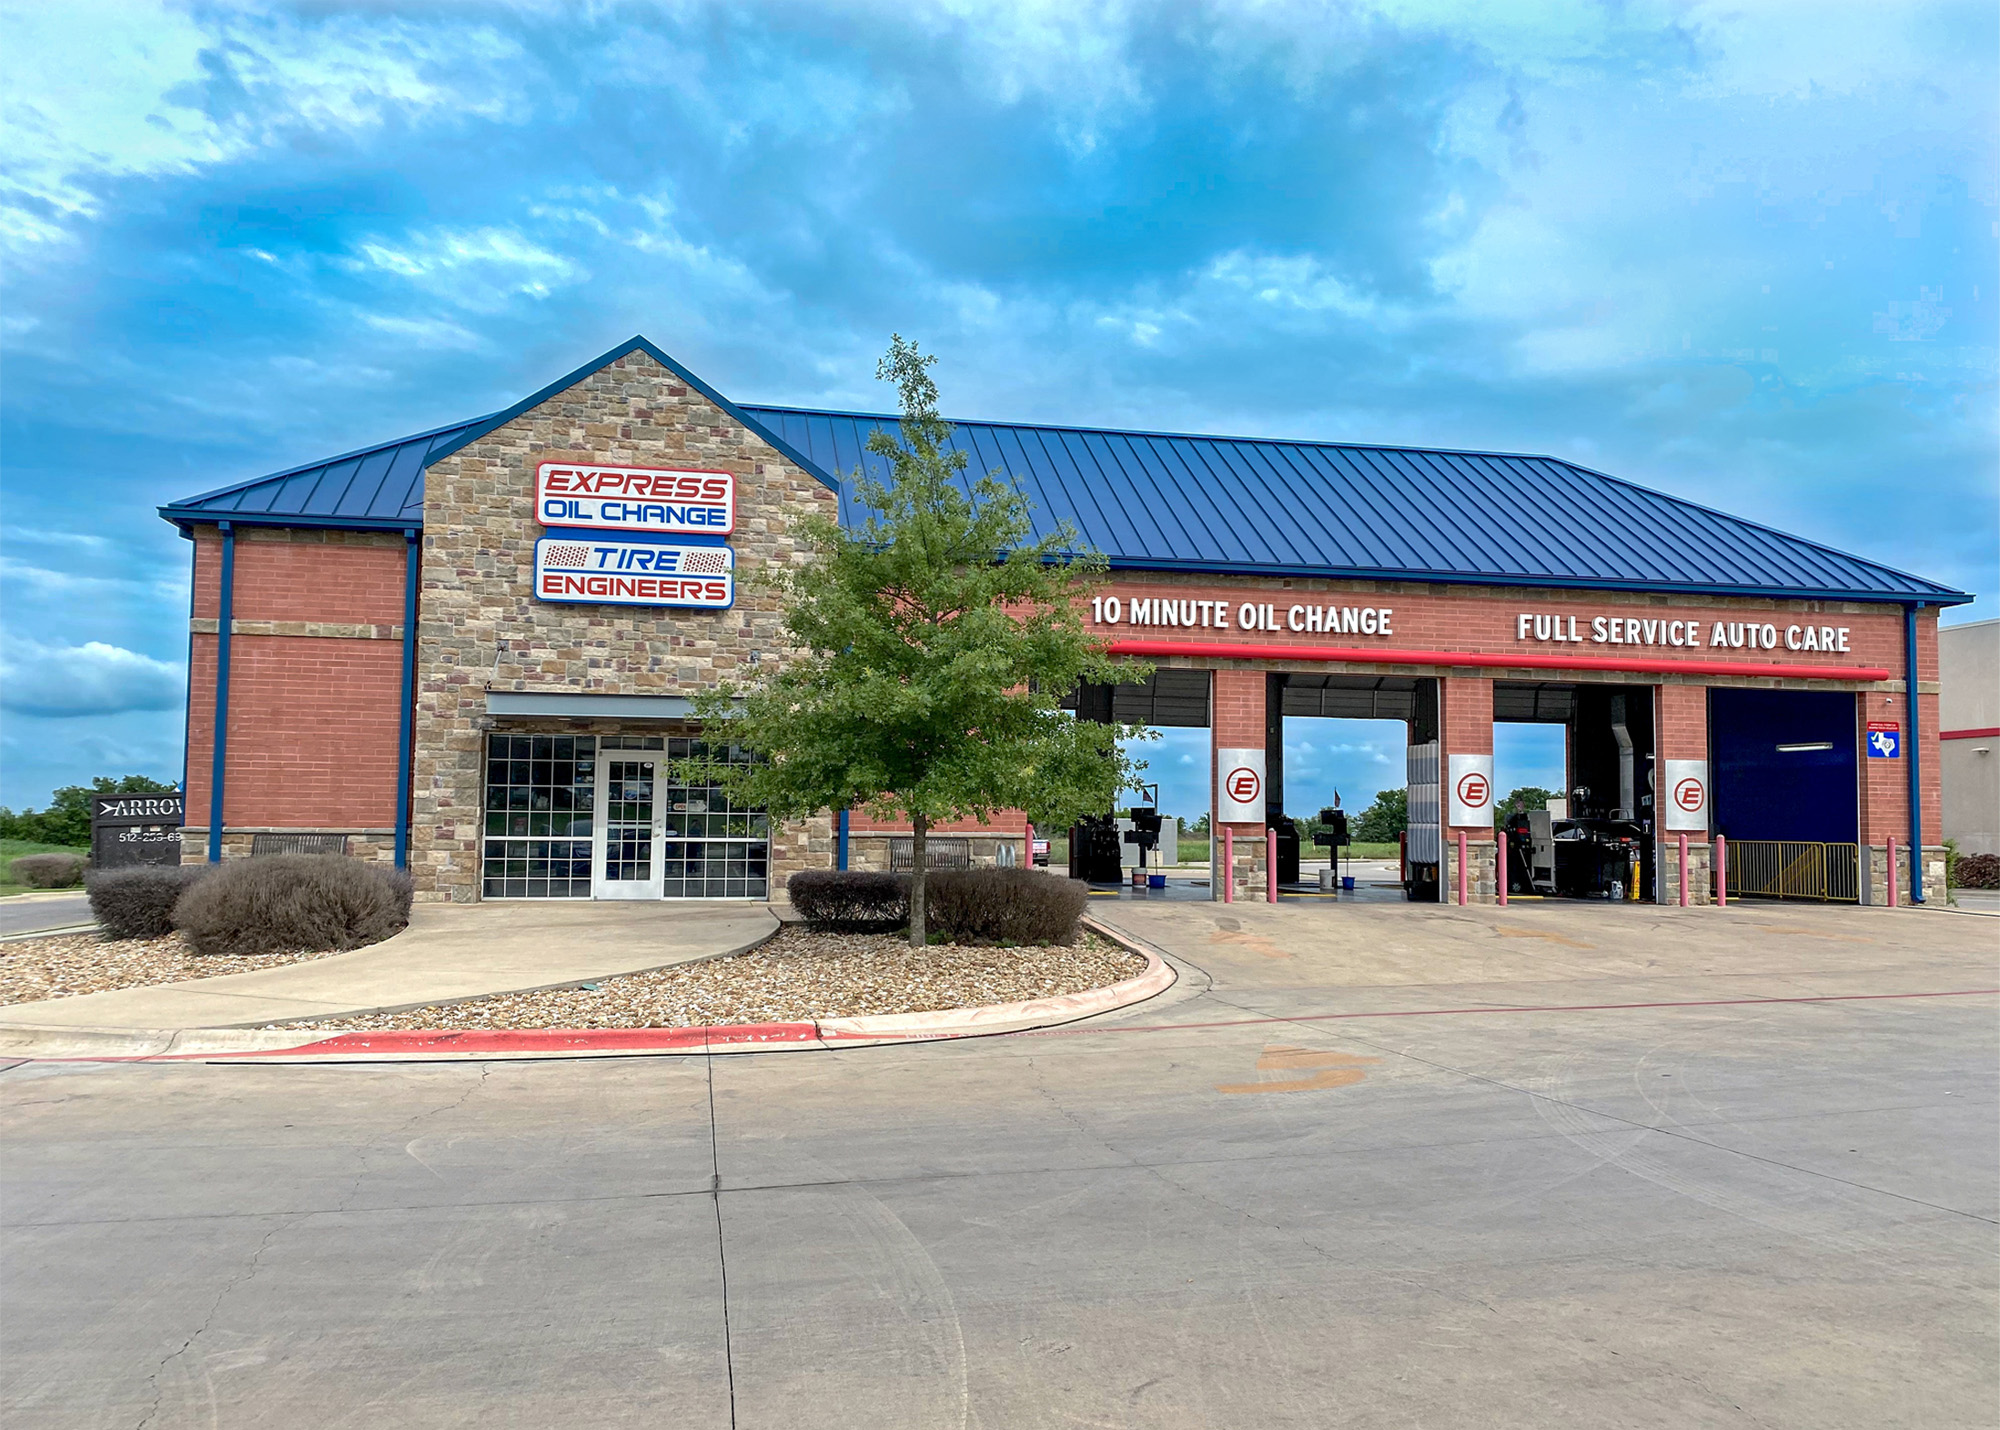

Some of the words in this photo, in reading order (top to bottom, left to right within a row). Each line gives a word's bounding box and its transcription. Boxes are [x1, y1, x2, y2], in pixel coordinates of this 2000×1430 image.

[544, 470, 728, 499] EXPRESS
[544, 500, 592, 519] OIL
[601, 502, 726, 526] CHANGE
[593, 547, 681, 571] TIRE
[543, 575, 726, 600] ENGINEERS
[1092, 596, 1121, 624] 10
[1130, 598, 1229, 628] MINUTE
[1238, 603, 1281, 631] OIL
[1288, 605, 1394, 635] CHANGE
[1518, 614, 1582, 642] FULL
[1592, 616, 1700, 647] SERVICE
[1711, 622, 1777, 650] AUTO
[1785, 625, 1851, 653] CARE
[1233, 777, 1254, 795] E
[1465, 783, 1485, 800] E
[1681, 787, 1700, 804] E
